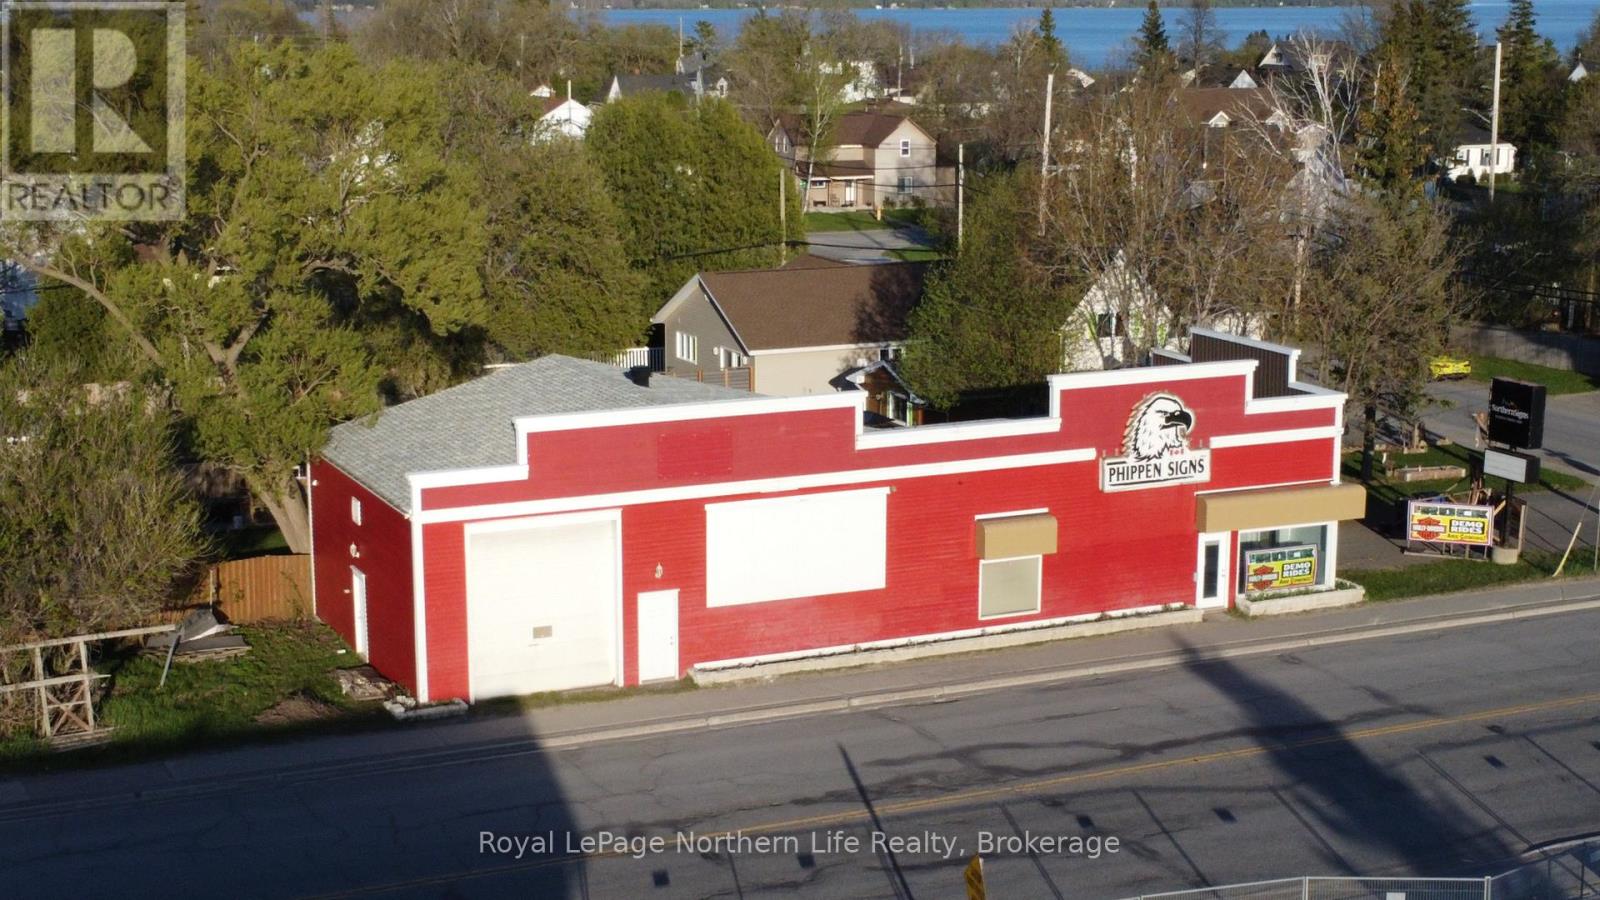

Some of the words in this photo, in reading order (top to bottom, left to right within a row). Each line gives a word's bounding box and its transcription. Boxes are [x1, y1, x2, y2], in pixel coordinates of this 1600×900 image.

[1109, 463, 1161, 482] PHIPPEN
[1168, 459, 1205, 476] SIGNS
[1283, 561, 1311, 570] DEMO
[1282, 568, 1310, 577] RIDES
